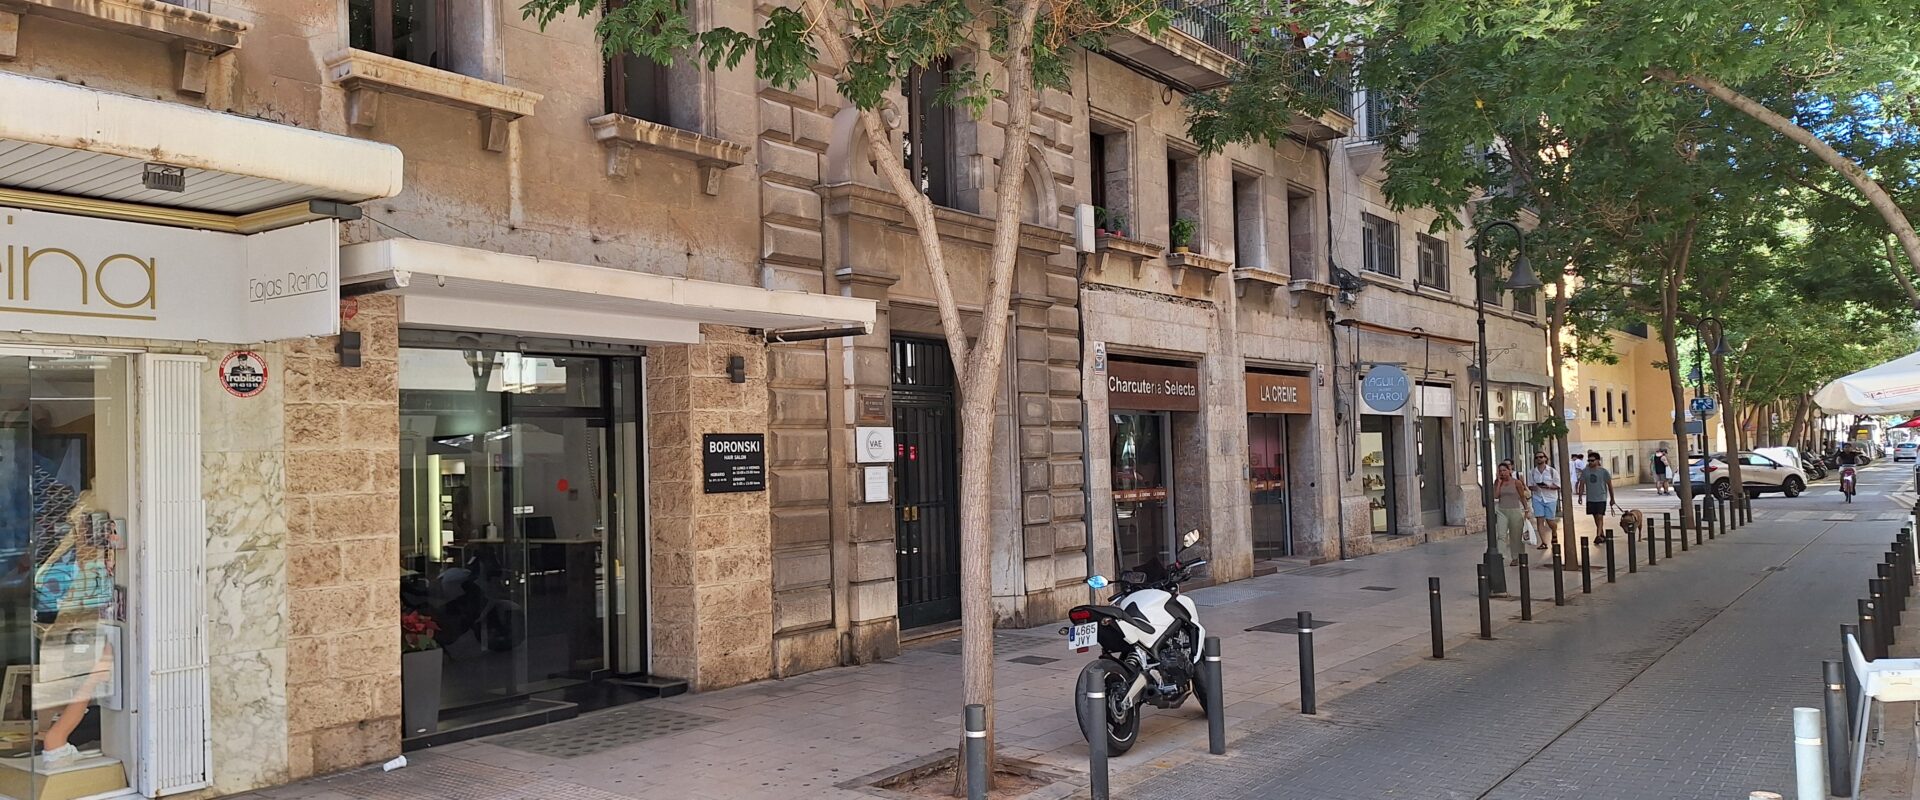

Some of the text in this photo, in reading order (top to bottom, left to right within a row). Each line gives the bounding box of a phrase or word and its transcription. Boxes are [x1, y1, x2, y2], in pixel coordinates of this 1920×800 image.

[0, 215, 156, 309] ina
[249, 265, 328, 304] Fajas Reina
[225, 373, 262, 382] Trablisa
[1165, 379, 1196, 396] Selecta
[1260, 385, 1271, 402] LA
[1365, 392, 1405, 401] CHAROL
[709, 441, 760, 453] BORONSKI
[869, 440, 882, 448] VAE
[1076, 623, 1096, 636] 4665
[1076, 635, 1091, 646] JVY
